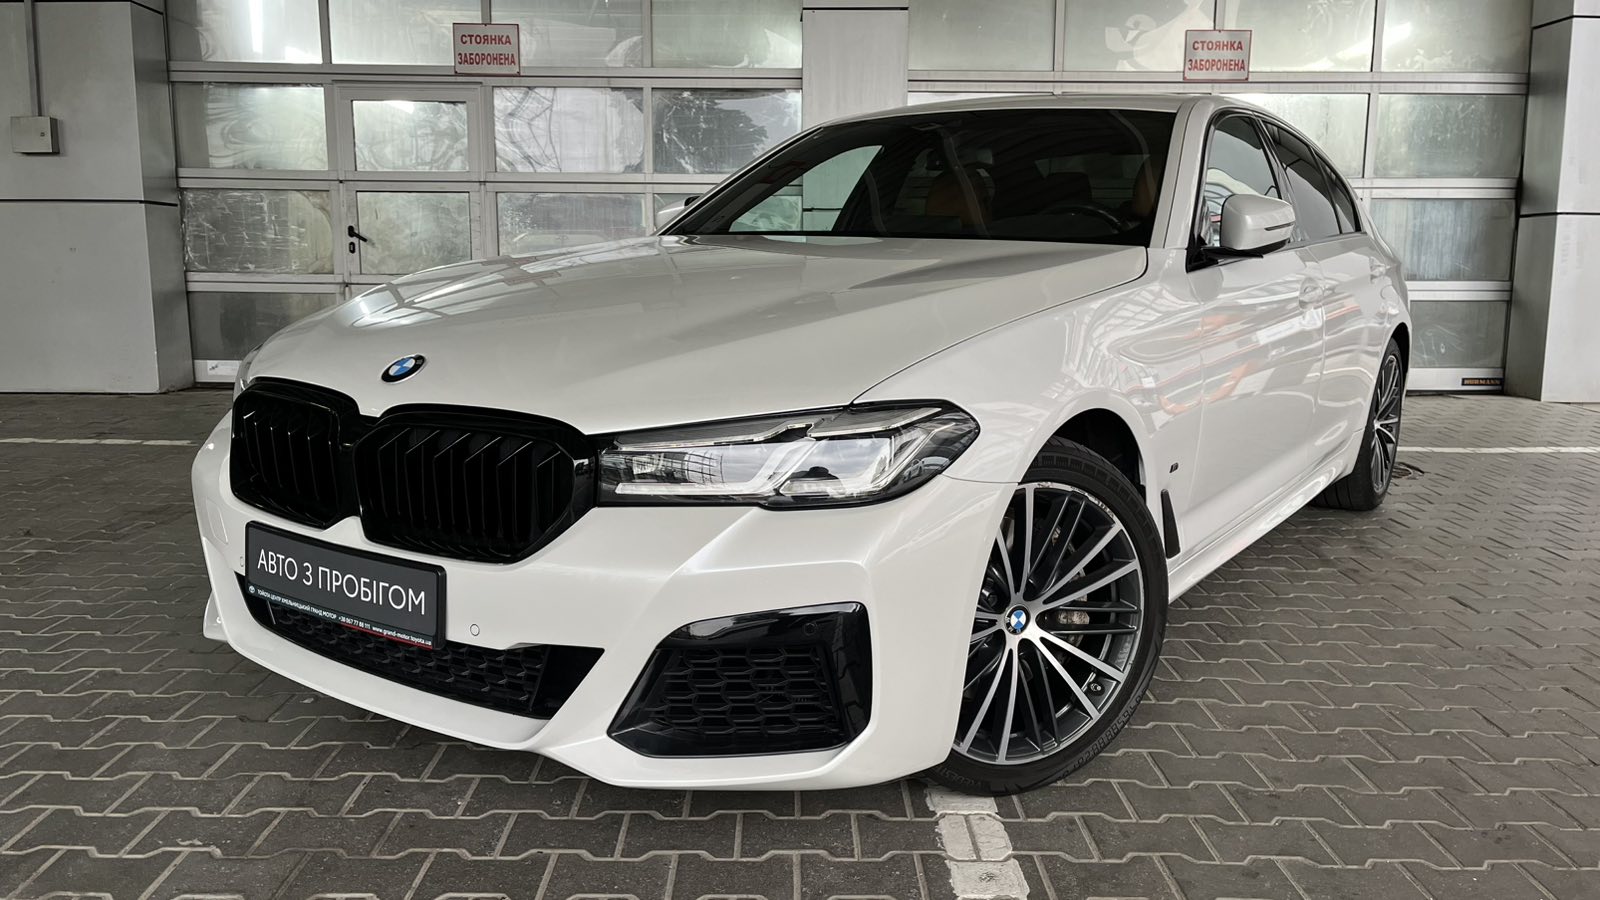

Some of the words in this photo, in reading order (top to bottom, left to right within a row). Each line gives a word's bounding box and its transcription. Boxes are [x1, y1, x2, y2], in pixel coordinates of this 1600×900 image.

[460, 34, 512, 45] СТОЯНКА
[1192, 40, 1243, 51] СТОЯНКА
[457, 52, 516, 66] ЗАБОРОНЕНА
[1187, 59, 1246, 72] ЗАБОРОНЕНА
[257, 548, 298, 581] АВТО
[318, 566, 426, 615] ПРОБІГОМ
